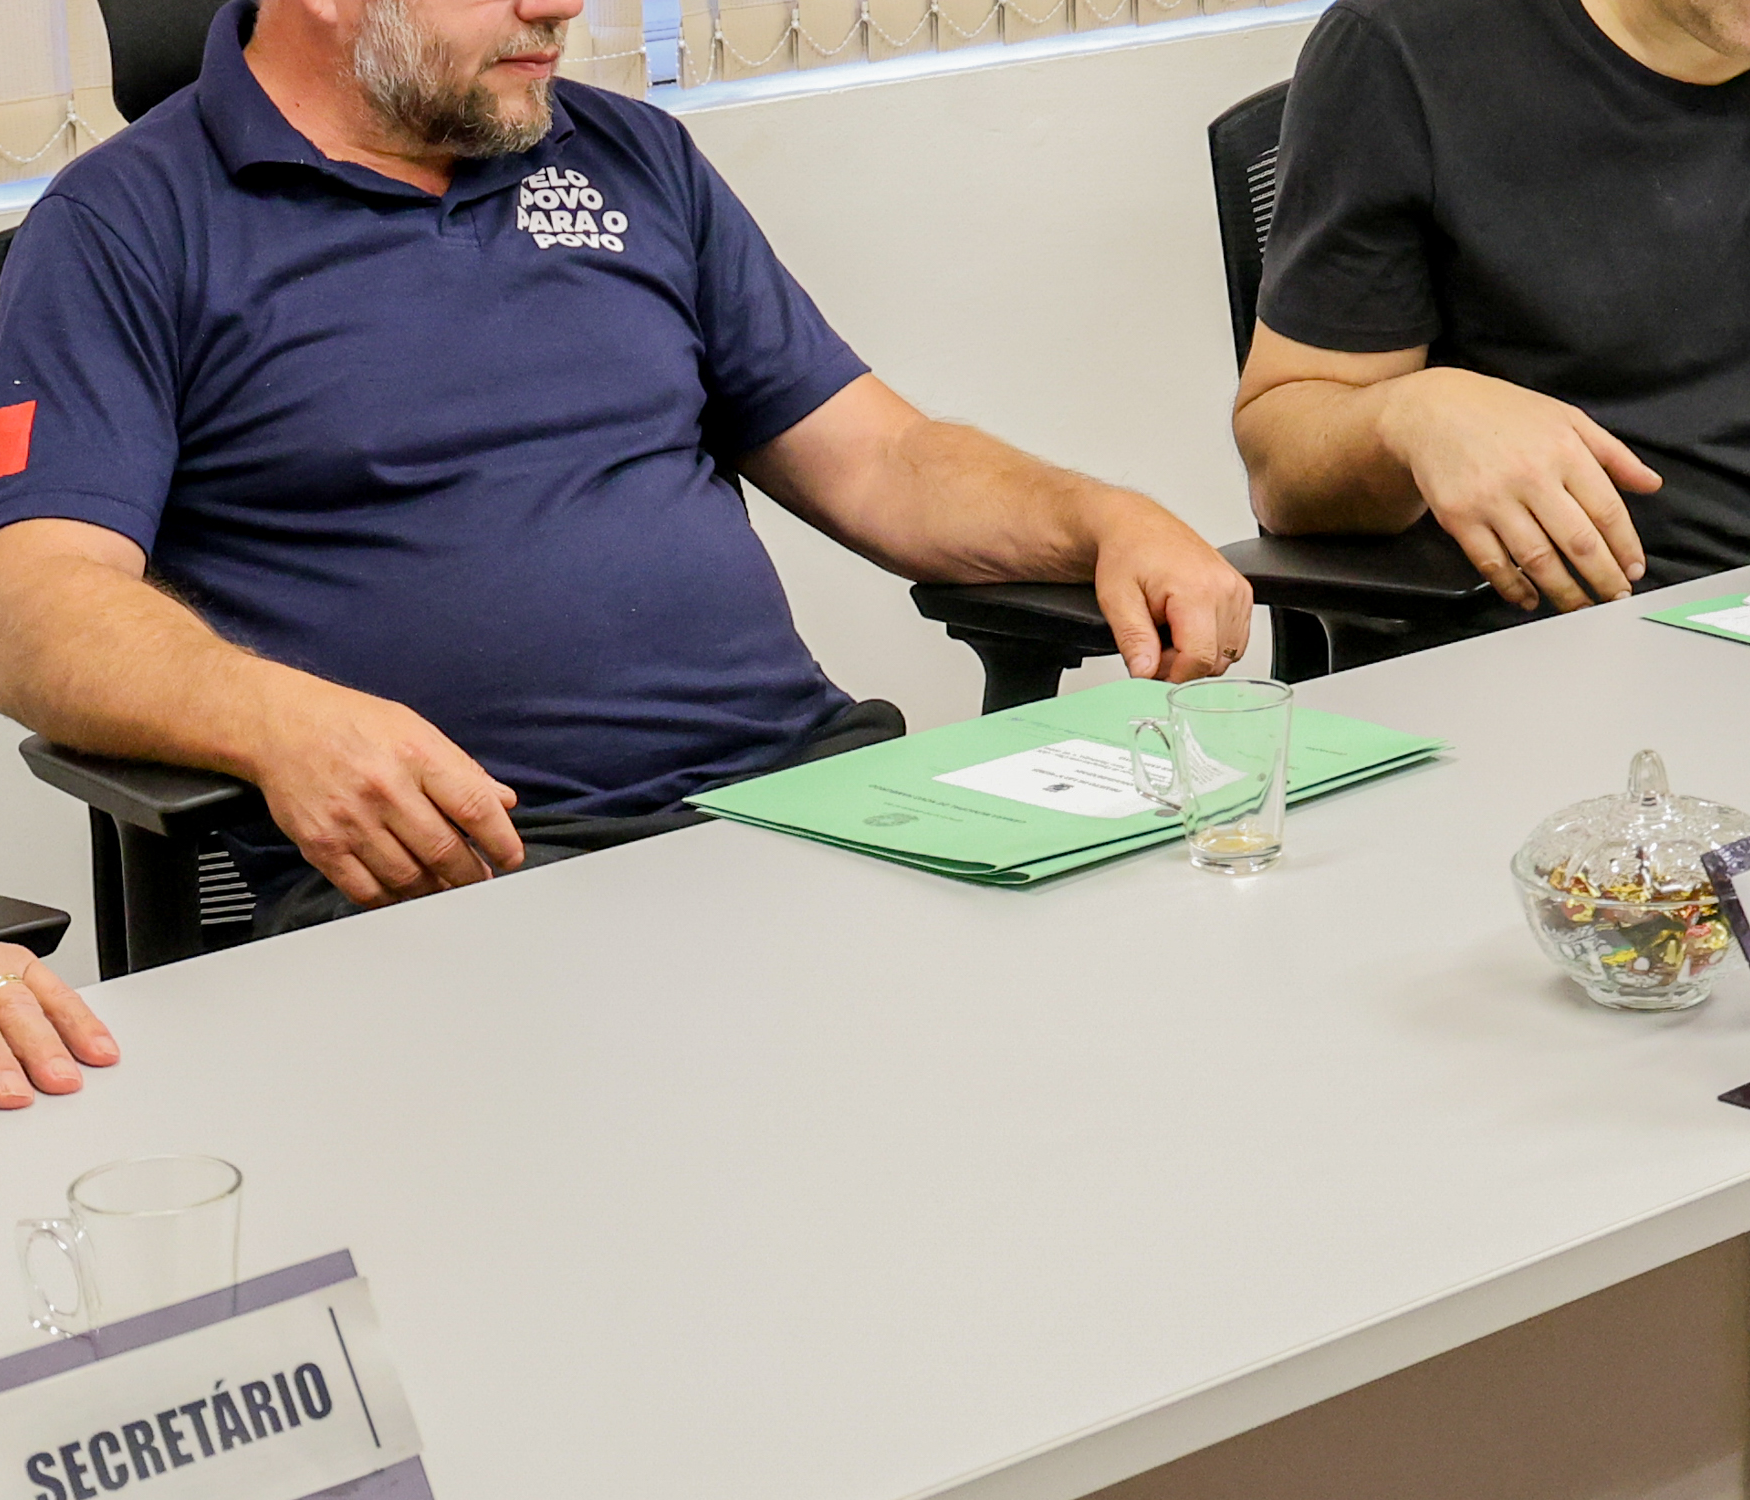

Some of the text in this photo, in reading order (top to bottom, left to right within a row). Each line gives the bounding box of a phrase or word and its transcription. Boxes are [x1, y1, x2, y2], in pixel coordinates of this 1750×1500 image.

[520, 185, 604, 211] POVO
[517, 205, 628, 234] PARA O
[532, 233, 624, 253] POVO
[26, 1362, 333, 1500] SECRETÁRIO
